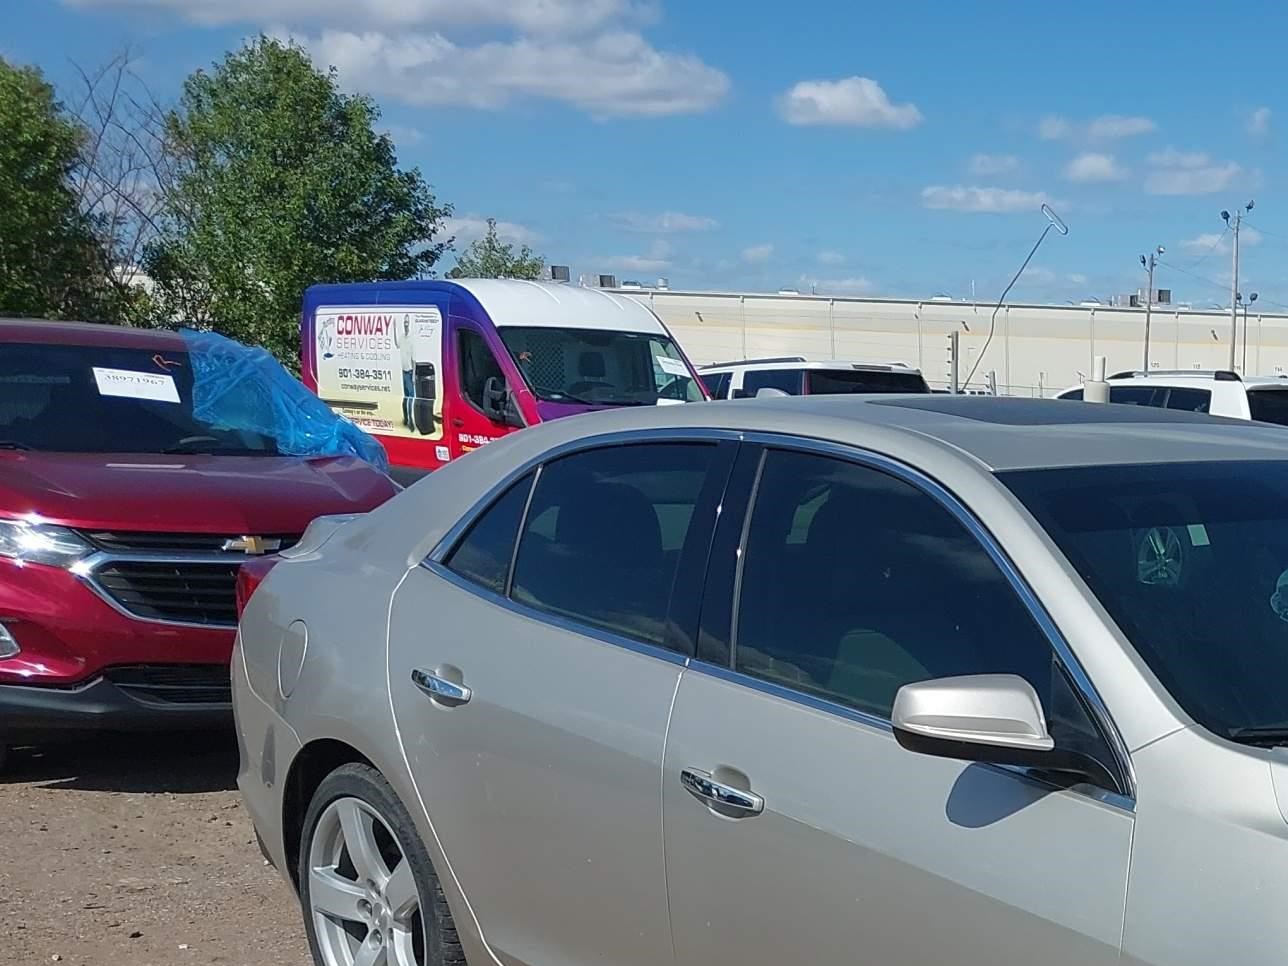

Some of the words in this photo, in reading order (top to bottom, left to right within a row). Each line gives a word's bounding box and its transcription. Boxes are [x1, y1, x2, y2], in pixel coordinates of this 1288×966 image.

[336, 315, 392, 336] CONWAY
[336, 337, 392, 350] SERVICES
[338, 368, 392, 381] 901-384-3511
